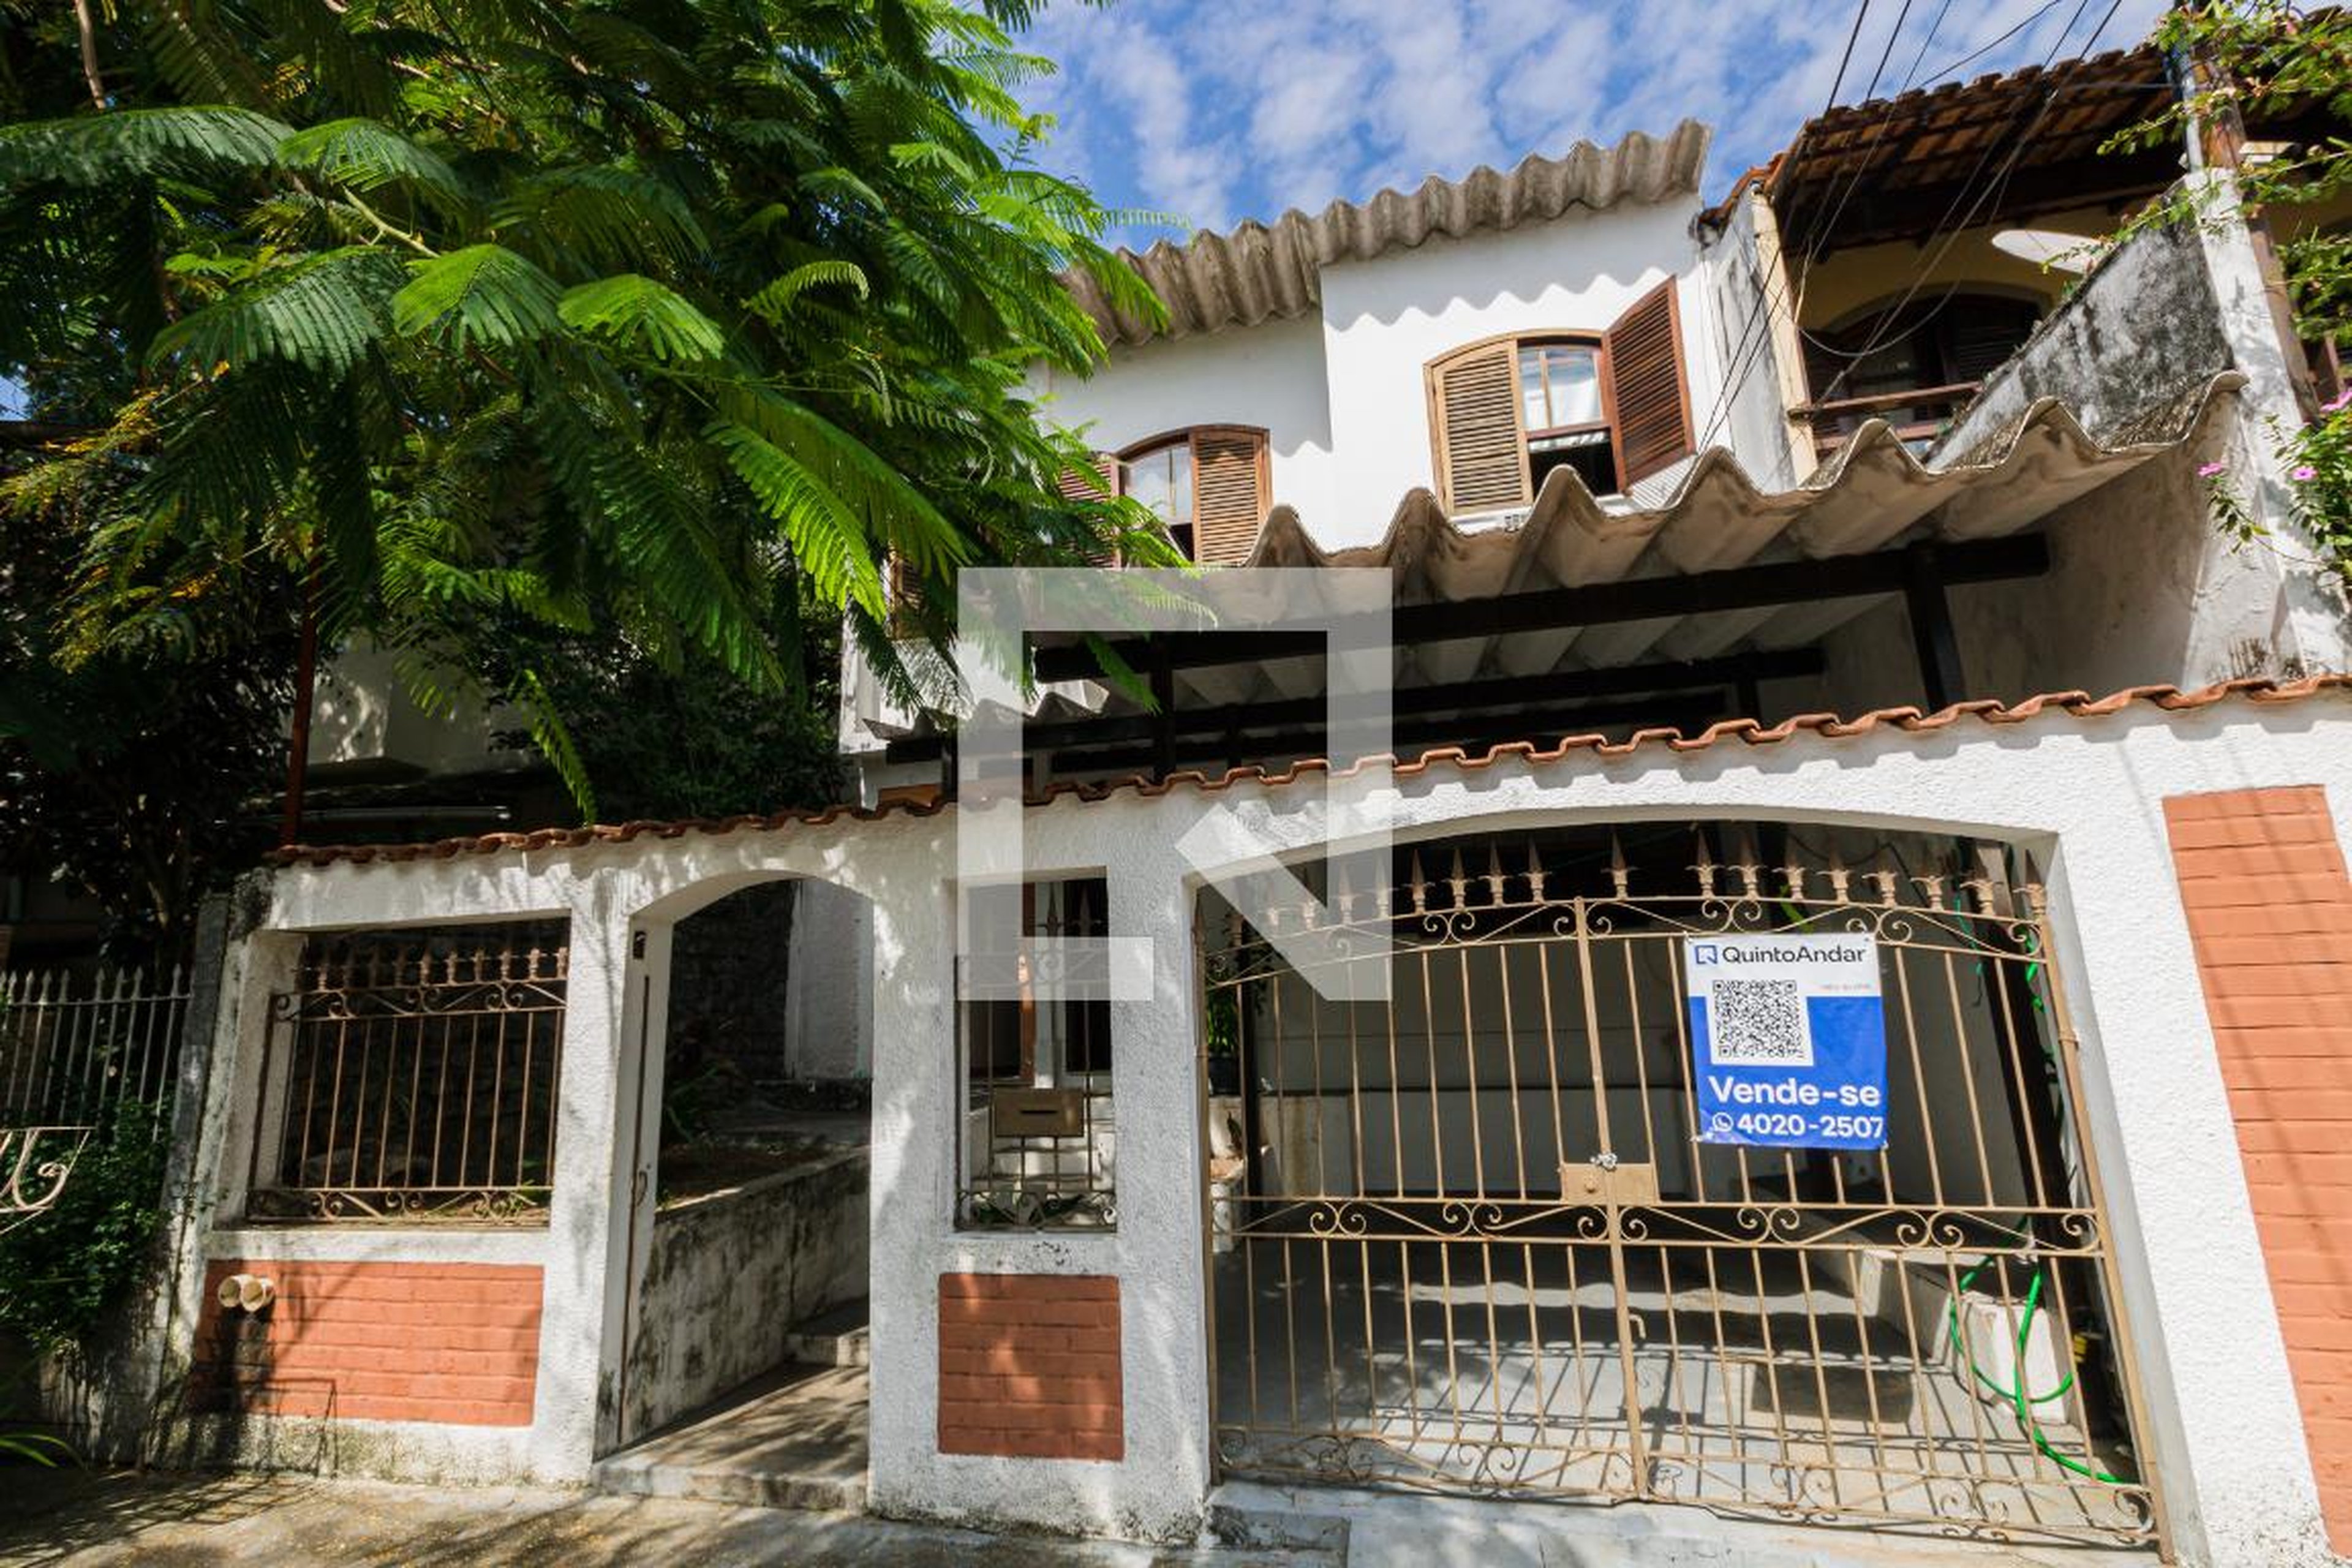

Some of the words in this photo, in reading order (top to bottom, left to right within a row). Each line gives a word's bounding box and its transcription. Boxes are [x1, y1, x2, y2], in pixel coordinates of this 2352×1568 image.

[1722, 945, 1866, 964] QuintoAndar
[1708, 1076, 1880, 1106] Vende-se
[1737, 1113, 1884, 1138] 4020-2507
